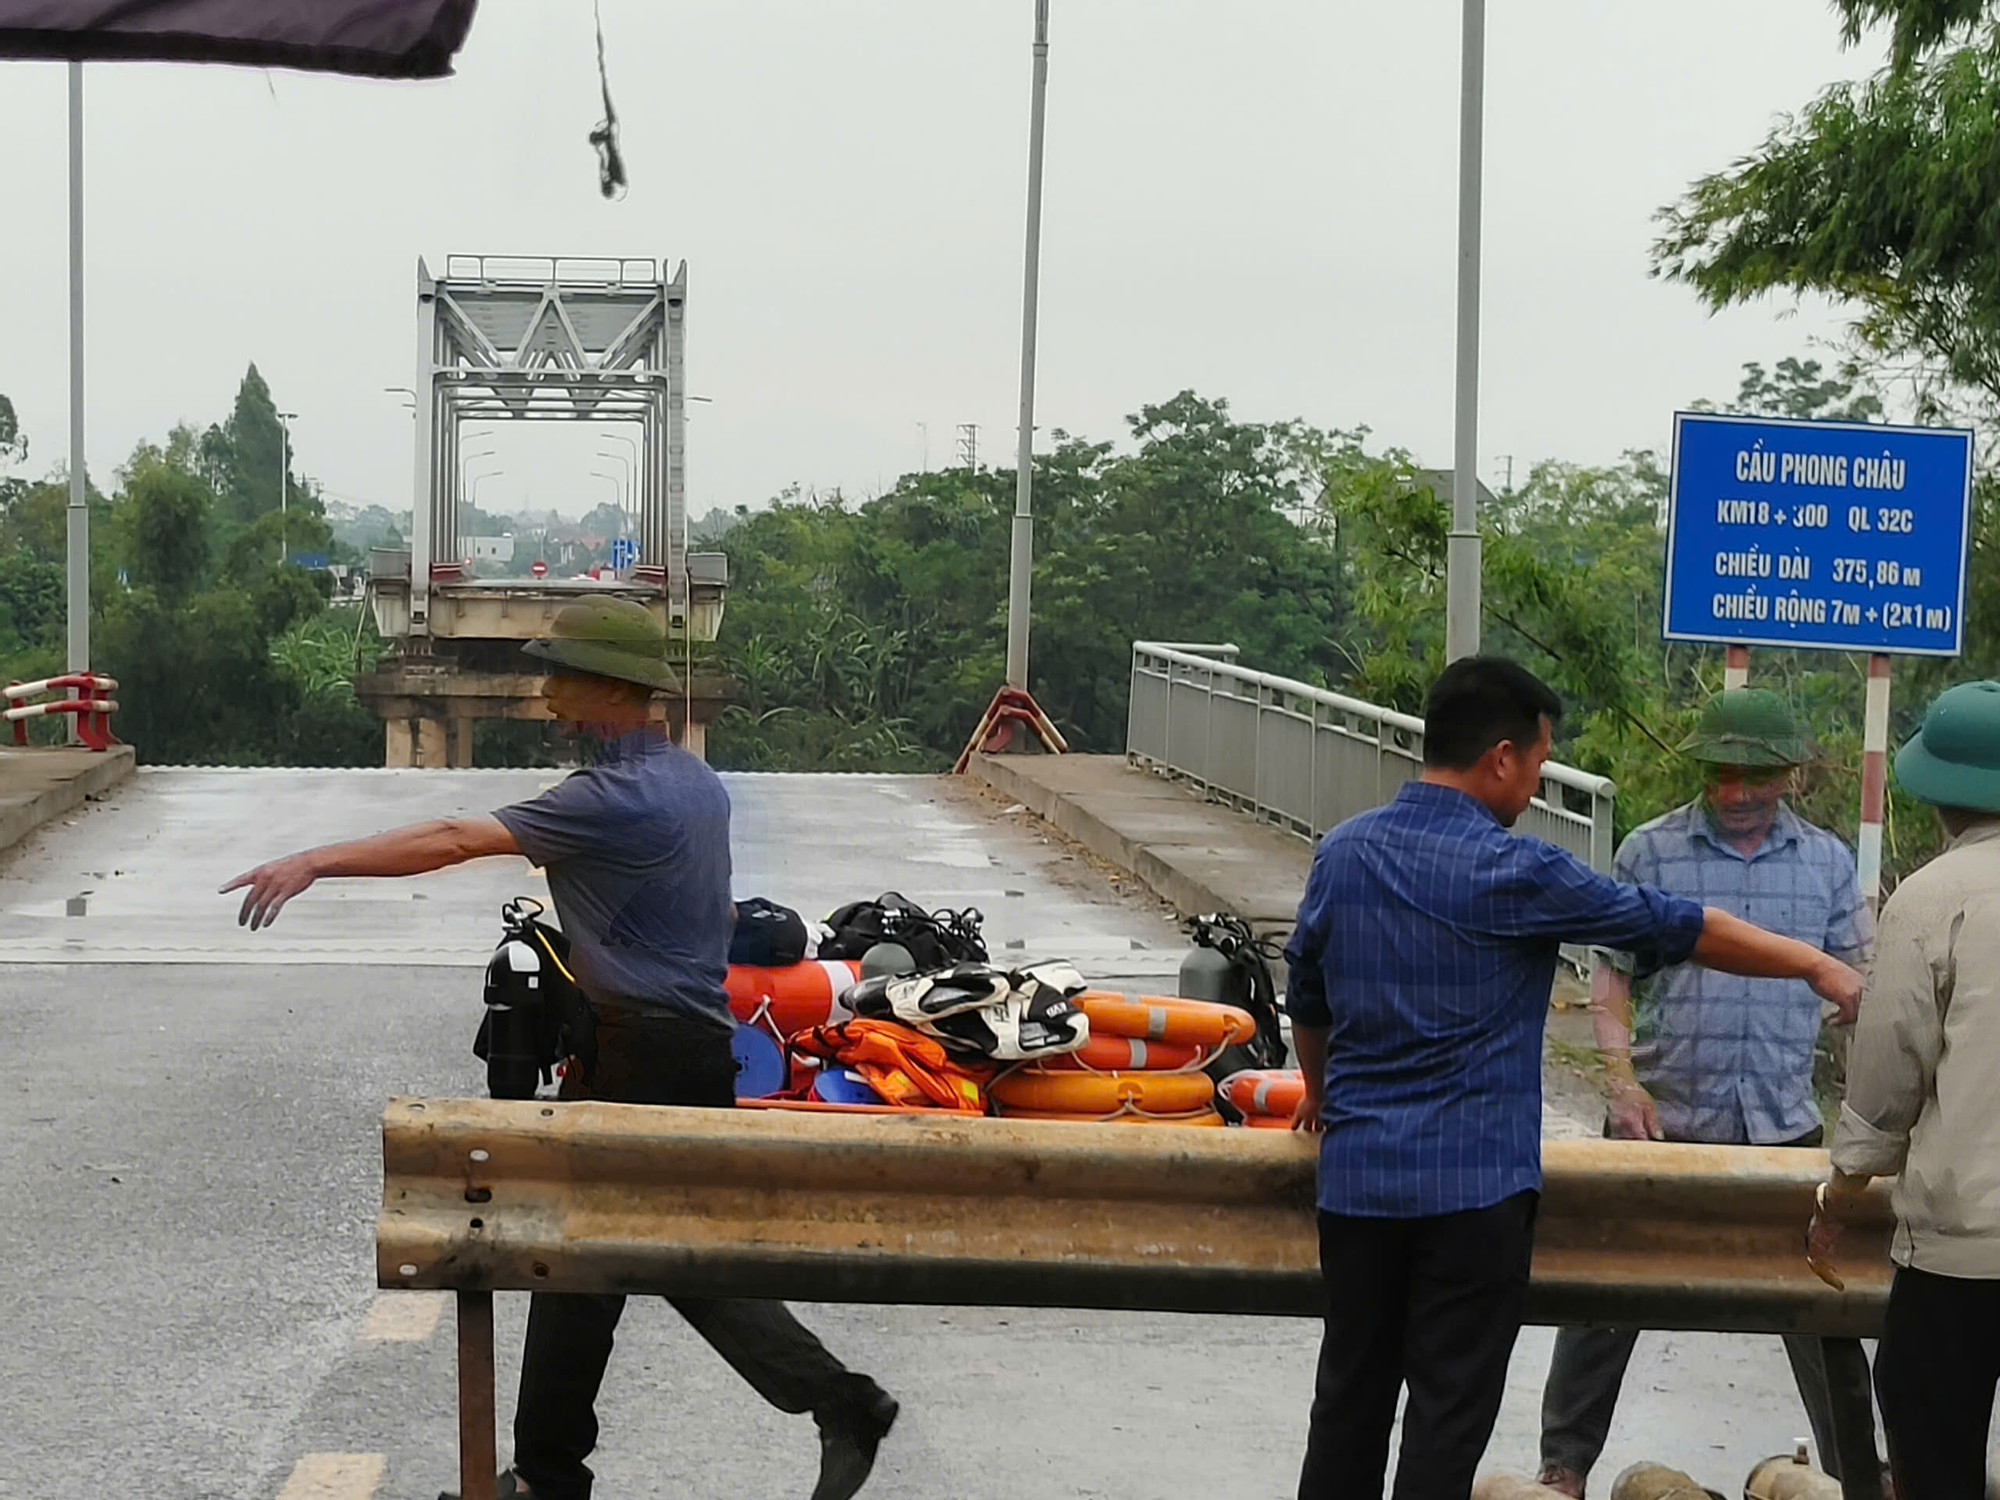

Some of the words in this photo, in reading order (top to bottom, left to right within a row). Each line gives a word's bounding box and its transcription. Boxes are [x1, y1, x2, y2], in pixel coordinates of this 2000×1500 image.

[1736, 438, 1776, 483] CẦU
[1780, 453, 1848, 487] PHONG
[1852, 450, 1906, 490] CHÂU
[1717, 499, 1770, 525] KM18
[1848, 506, 1871, 533] QL
[1877, 508, 1914, 533] 32C
[1715, 543, 1772, 578] CHIỀU
[1778, 546, 1811, 580] DÀI
[1712, 583, 1768, 620] CHIỀU
[1774, 589, 1826, 629] RỘNG
